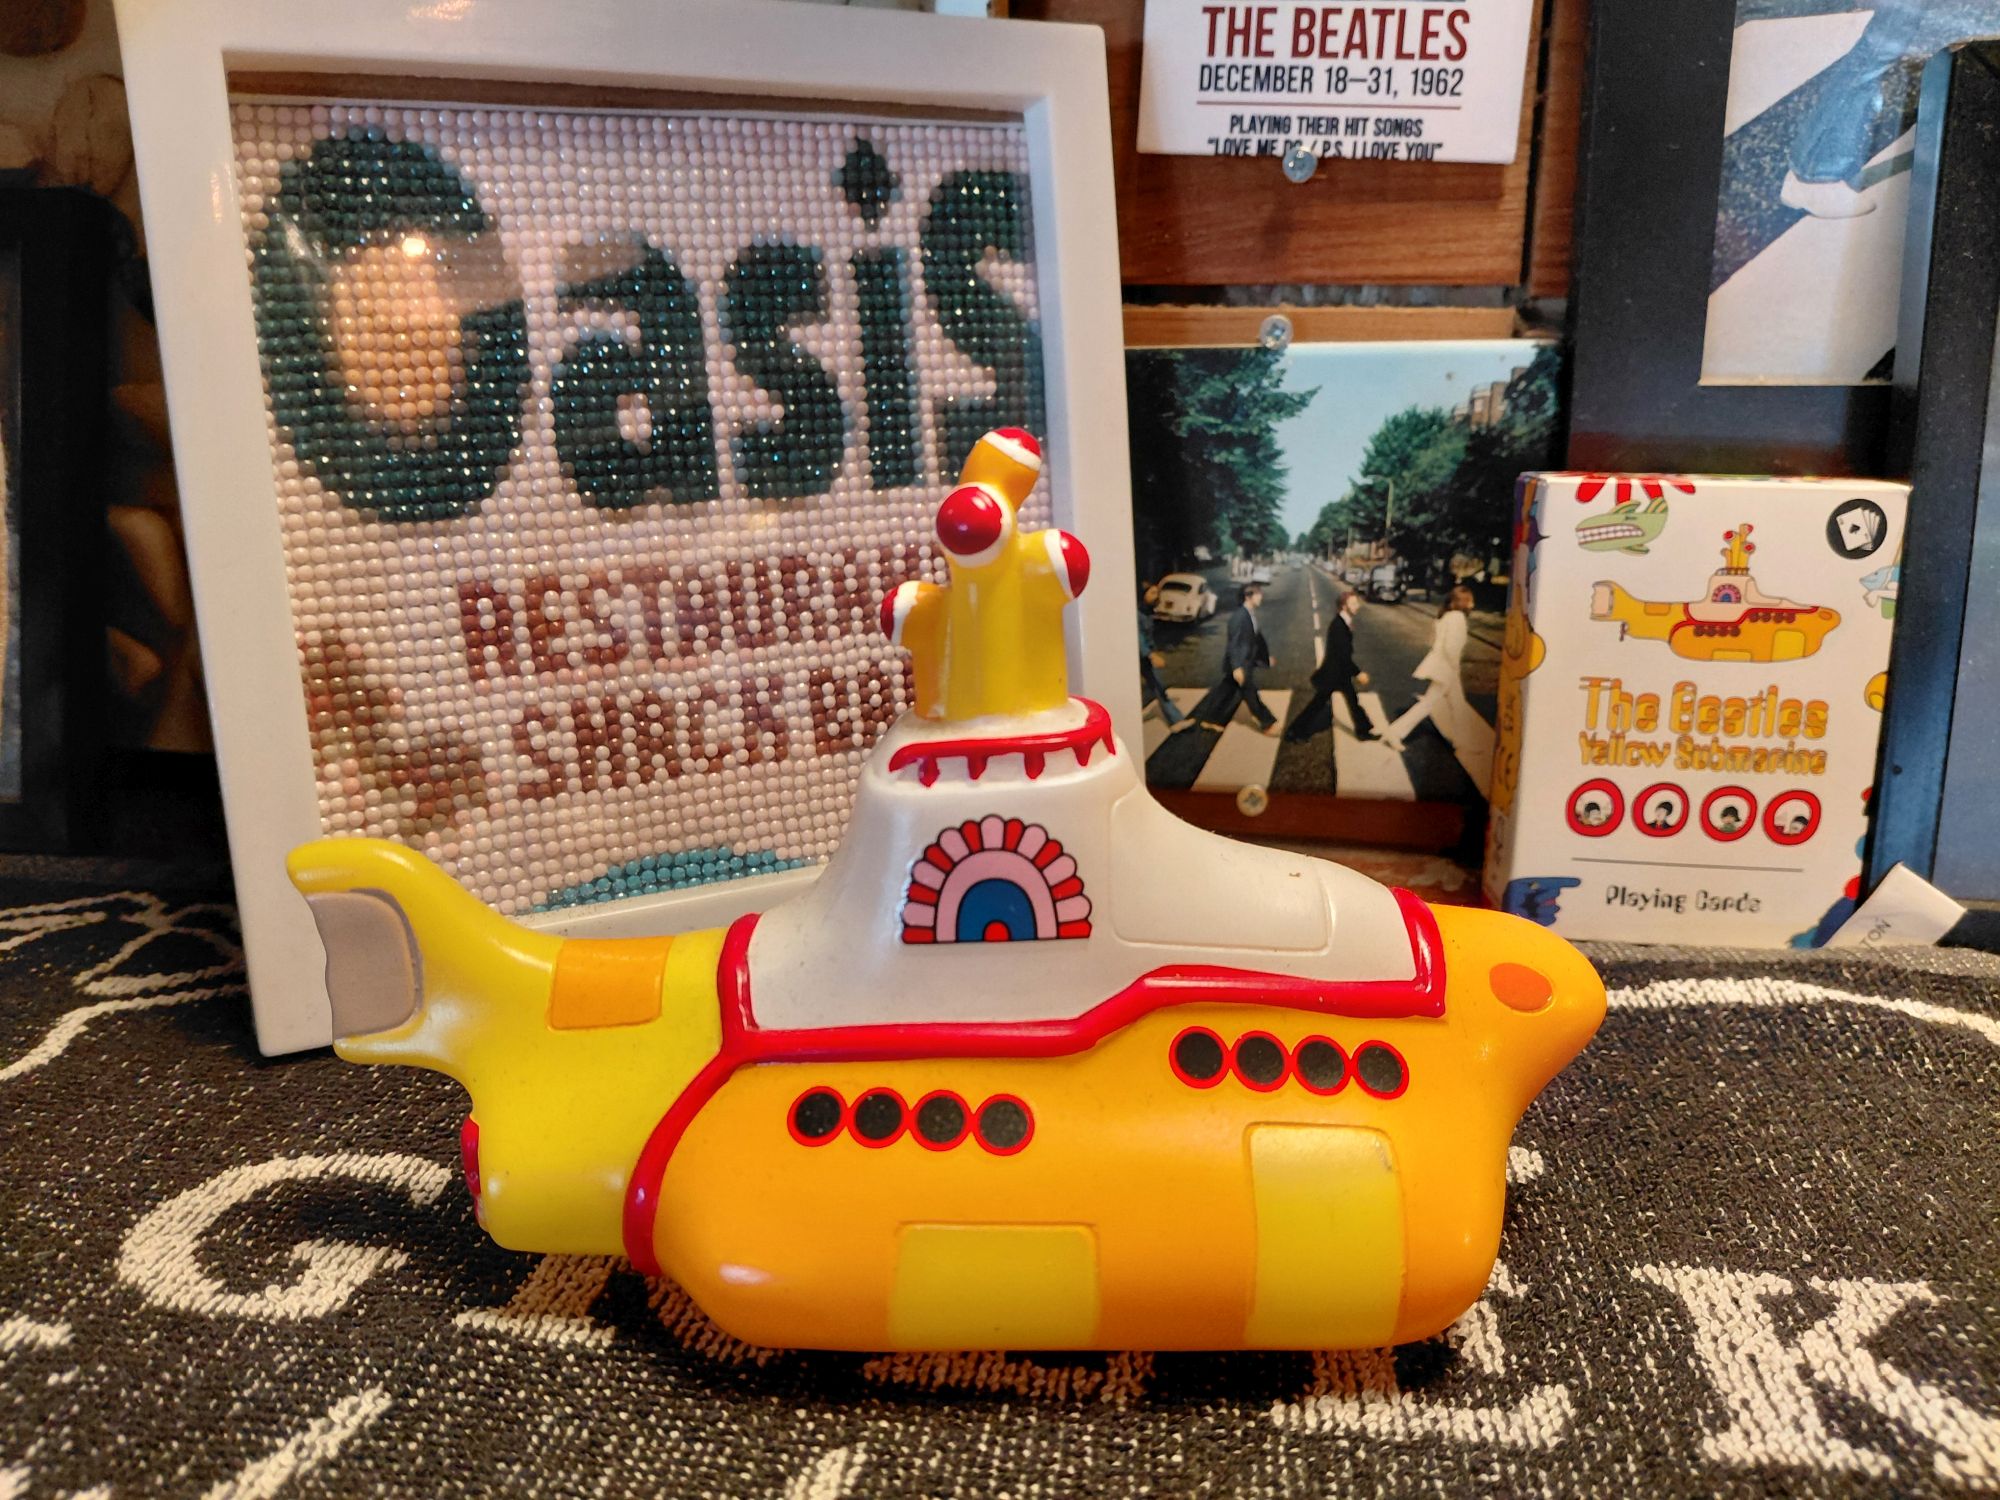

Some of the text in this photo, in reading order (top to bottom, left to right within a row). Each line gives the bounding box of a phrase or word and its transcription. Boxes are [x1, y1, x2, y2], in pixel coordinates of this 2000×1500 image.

[1202, 7, 1470, 62] THE BEATLES
[1199, 63, 1314, 94] DECEMBER
[1411, 68, 1464, 97] 1962
[1229, 114, 1424, 138] PLAYING THEIR HIT SONGS
[1257, 139, 1278, 157] ME
[1362, 142, 1400, 159] LOVE
[1579, 676, 1829, 740] The Beatles
[513, 657, 914, 799] SNACK BA
[1578, 730, 1828, 775] Yellow Submarine
[1605, 884, 1762, 914] Playing Cards
